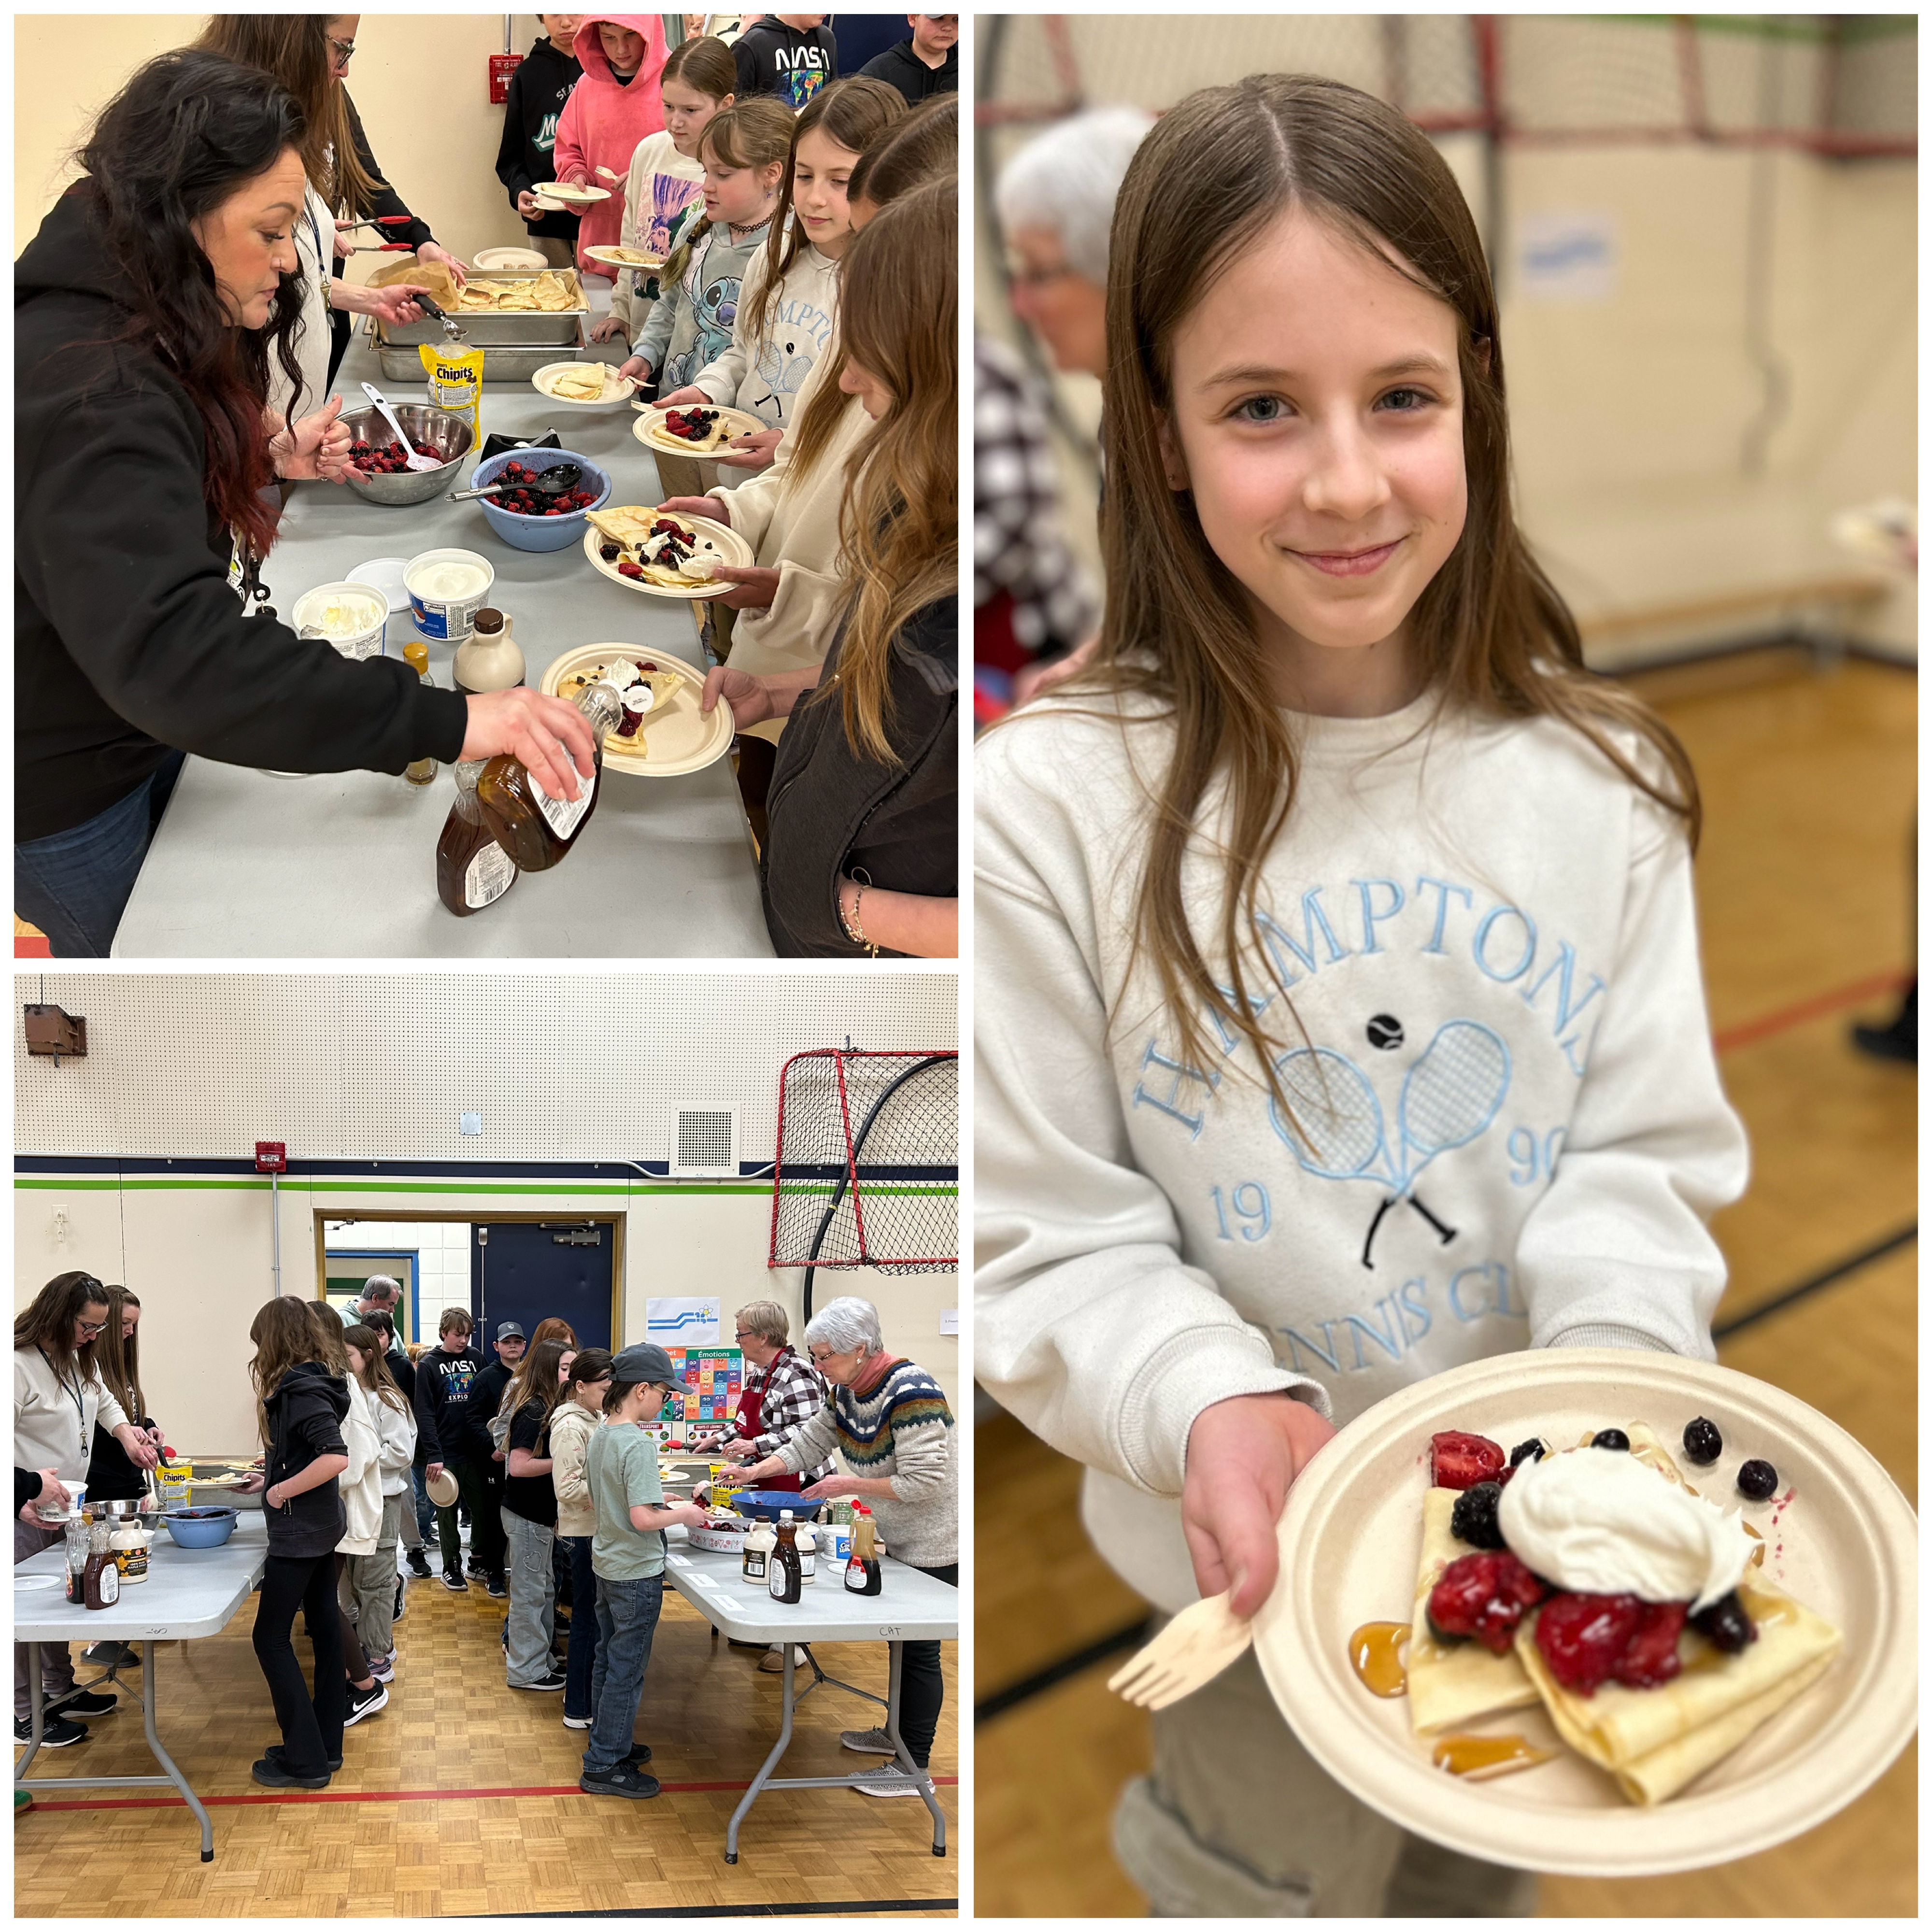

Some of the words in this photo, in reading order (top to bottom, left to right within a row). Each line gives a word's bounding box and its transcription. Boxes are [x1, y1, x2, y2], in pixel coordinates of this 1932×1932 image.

[775, 46, 830, 71] NASA
[437, 367, 473, 382] Chipits
[1210, 1180, 1271, 1242] 19
[439, 1360, 477, 1375] NASA
[164, 1474, 185, 1482] Chipits
[880, 1626, 901, 1636] CAT
